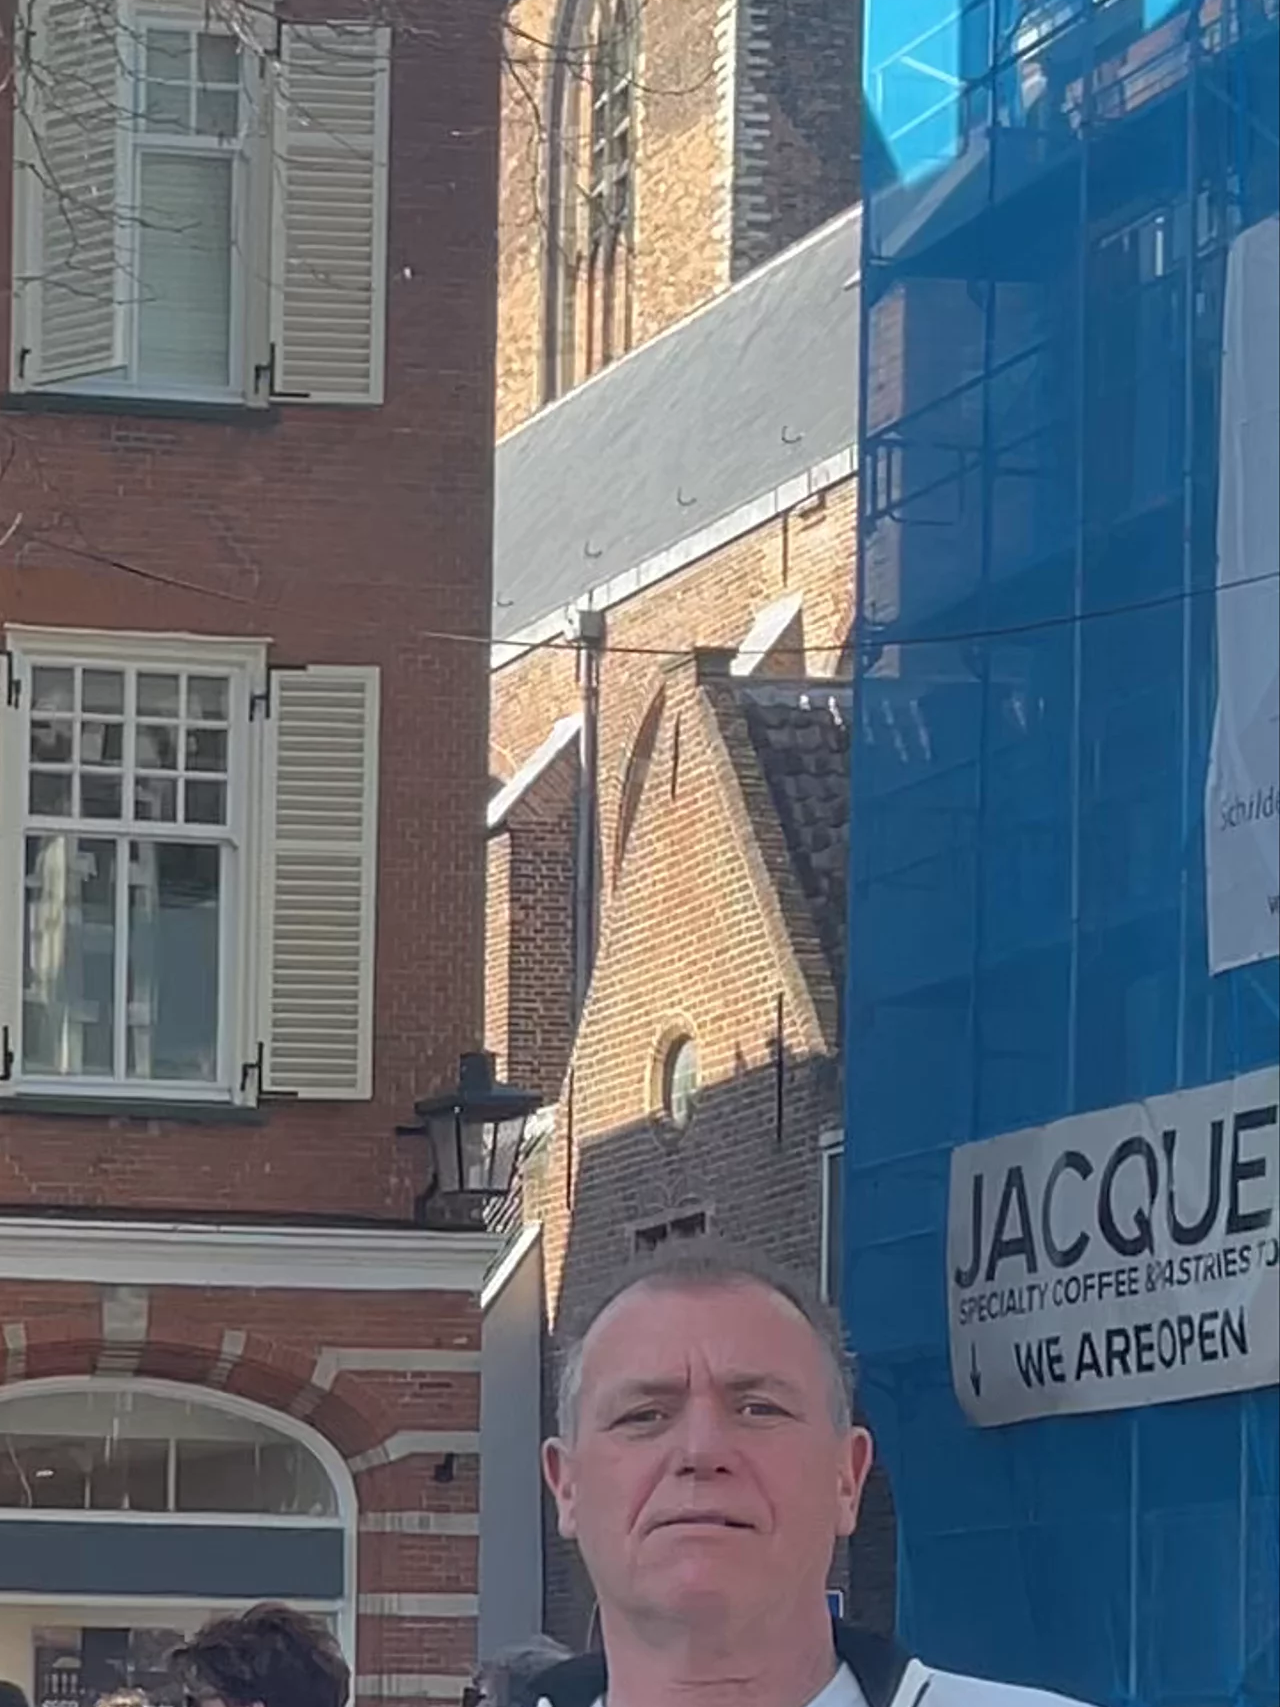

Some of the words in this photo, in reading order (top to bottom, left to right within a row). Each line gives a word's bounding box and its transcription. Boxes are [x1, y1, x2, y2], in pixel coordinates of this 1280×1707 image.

[1220, 785, 1280, 832] Schild
[954, 1104, 1278, 1290] JACQUE
[959, 1283, 1048, 1325] SPECIALTY
[1052, 1266, 1140, 1306] COFFEE
[1014, 1336, 1066, 1390] WE
